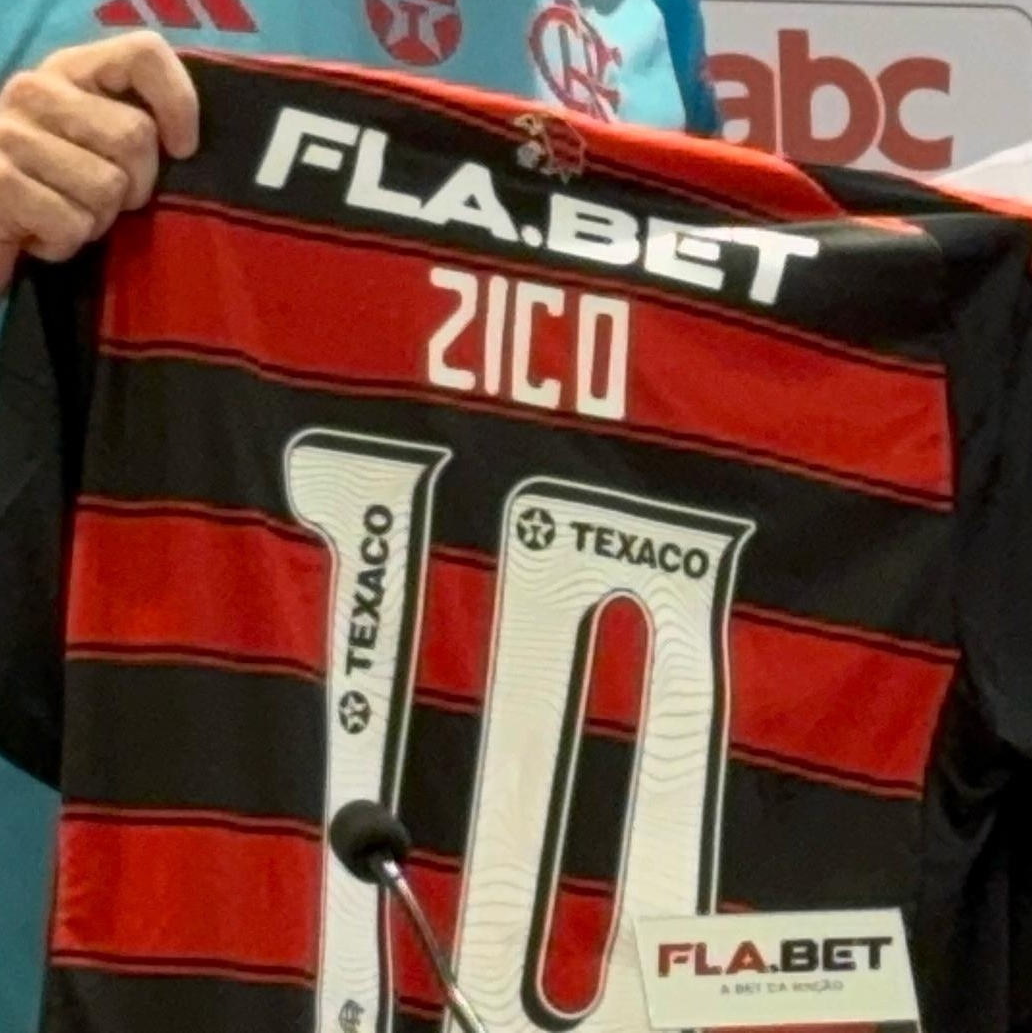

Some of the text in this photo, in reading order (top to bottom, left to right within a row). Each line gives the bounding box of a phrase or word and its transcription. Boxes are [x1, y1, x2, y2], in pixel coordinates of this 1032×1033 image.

[706, 29, 953, 171] abc
[255, 107, 819, 304] FLA.BET
[428, 268, 629, 420] ZICO
[345, 504, 393, 676] TEXACO
[569, 521, 709, 579] TEXACO
[658, 936, 893, 978] FLA.BET
